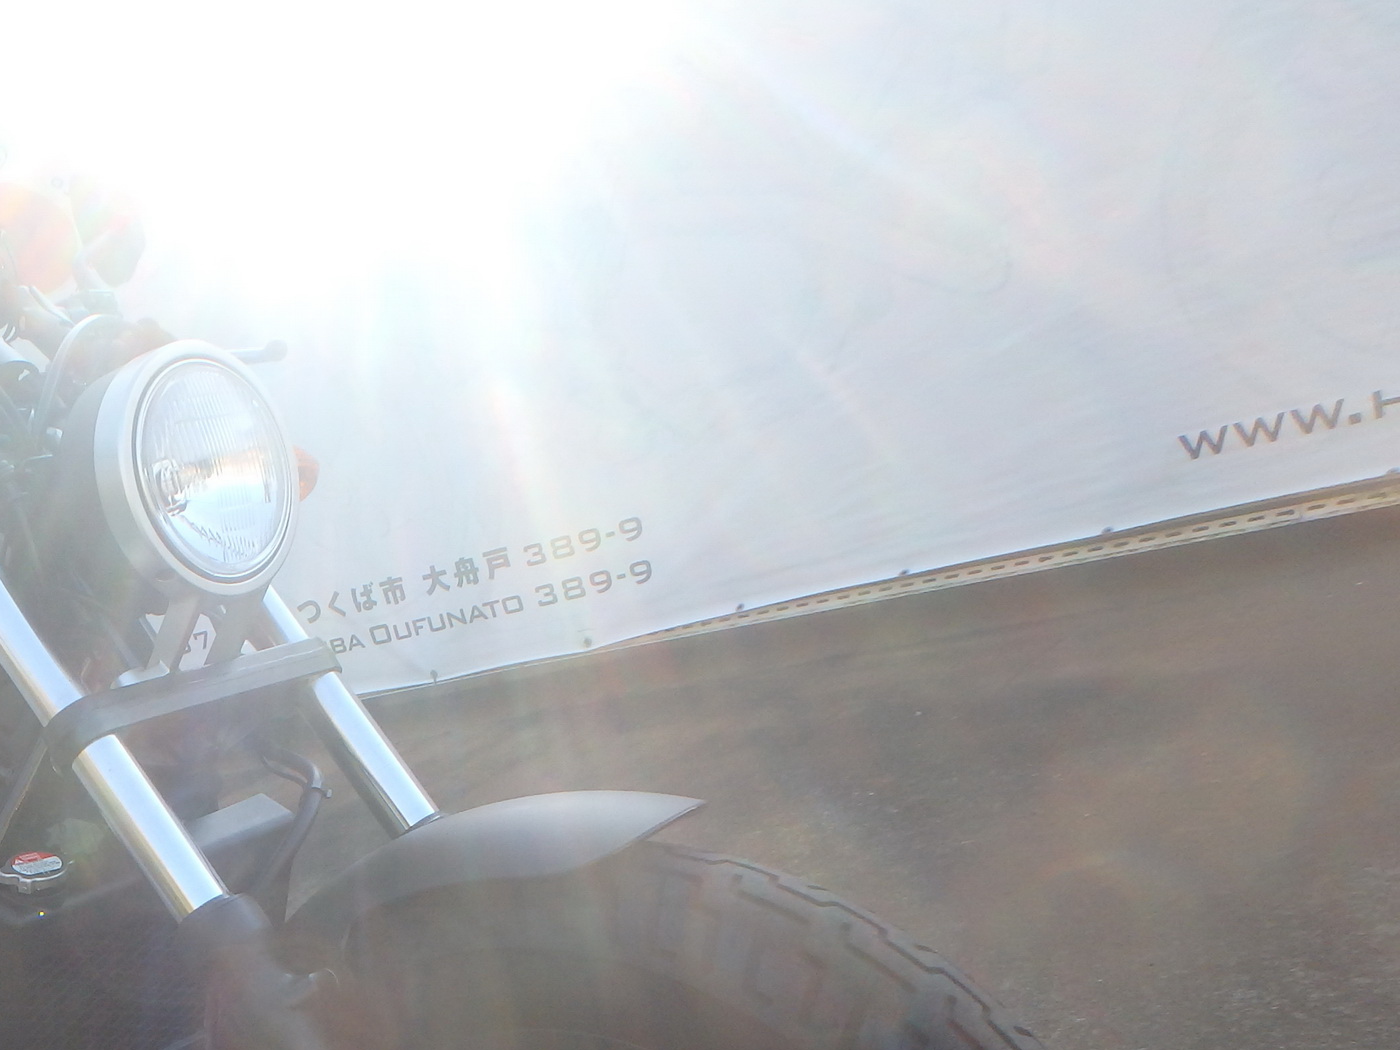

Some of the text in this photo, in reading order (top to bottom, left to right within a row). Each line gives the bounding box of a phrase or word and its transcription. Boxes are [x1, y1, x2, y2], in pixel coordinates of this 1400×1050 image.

[297, 576, 406, 624] つくば市
[422, 547, 511, 597] 大舟戸
[523, 516, 643, 567] 389-9
[369, 594, 524, 645] OUFUNATO
[534, 559, 653, 608] 389-9
